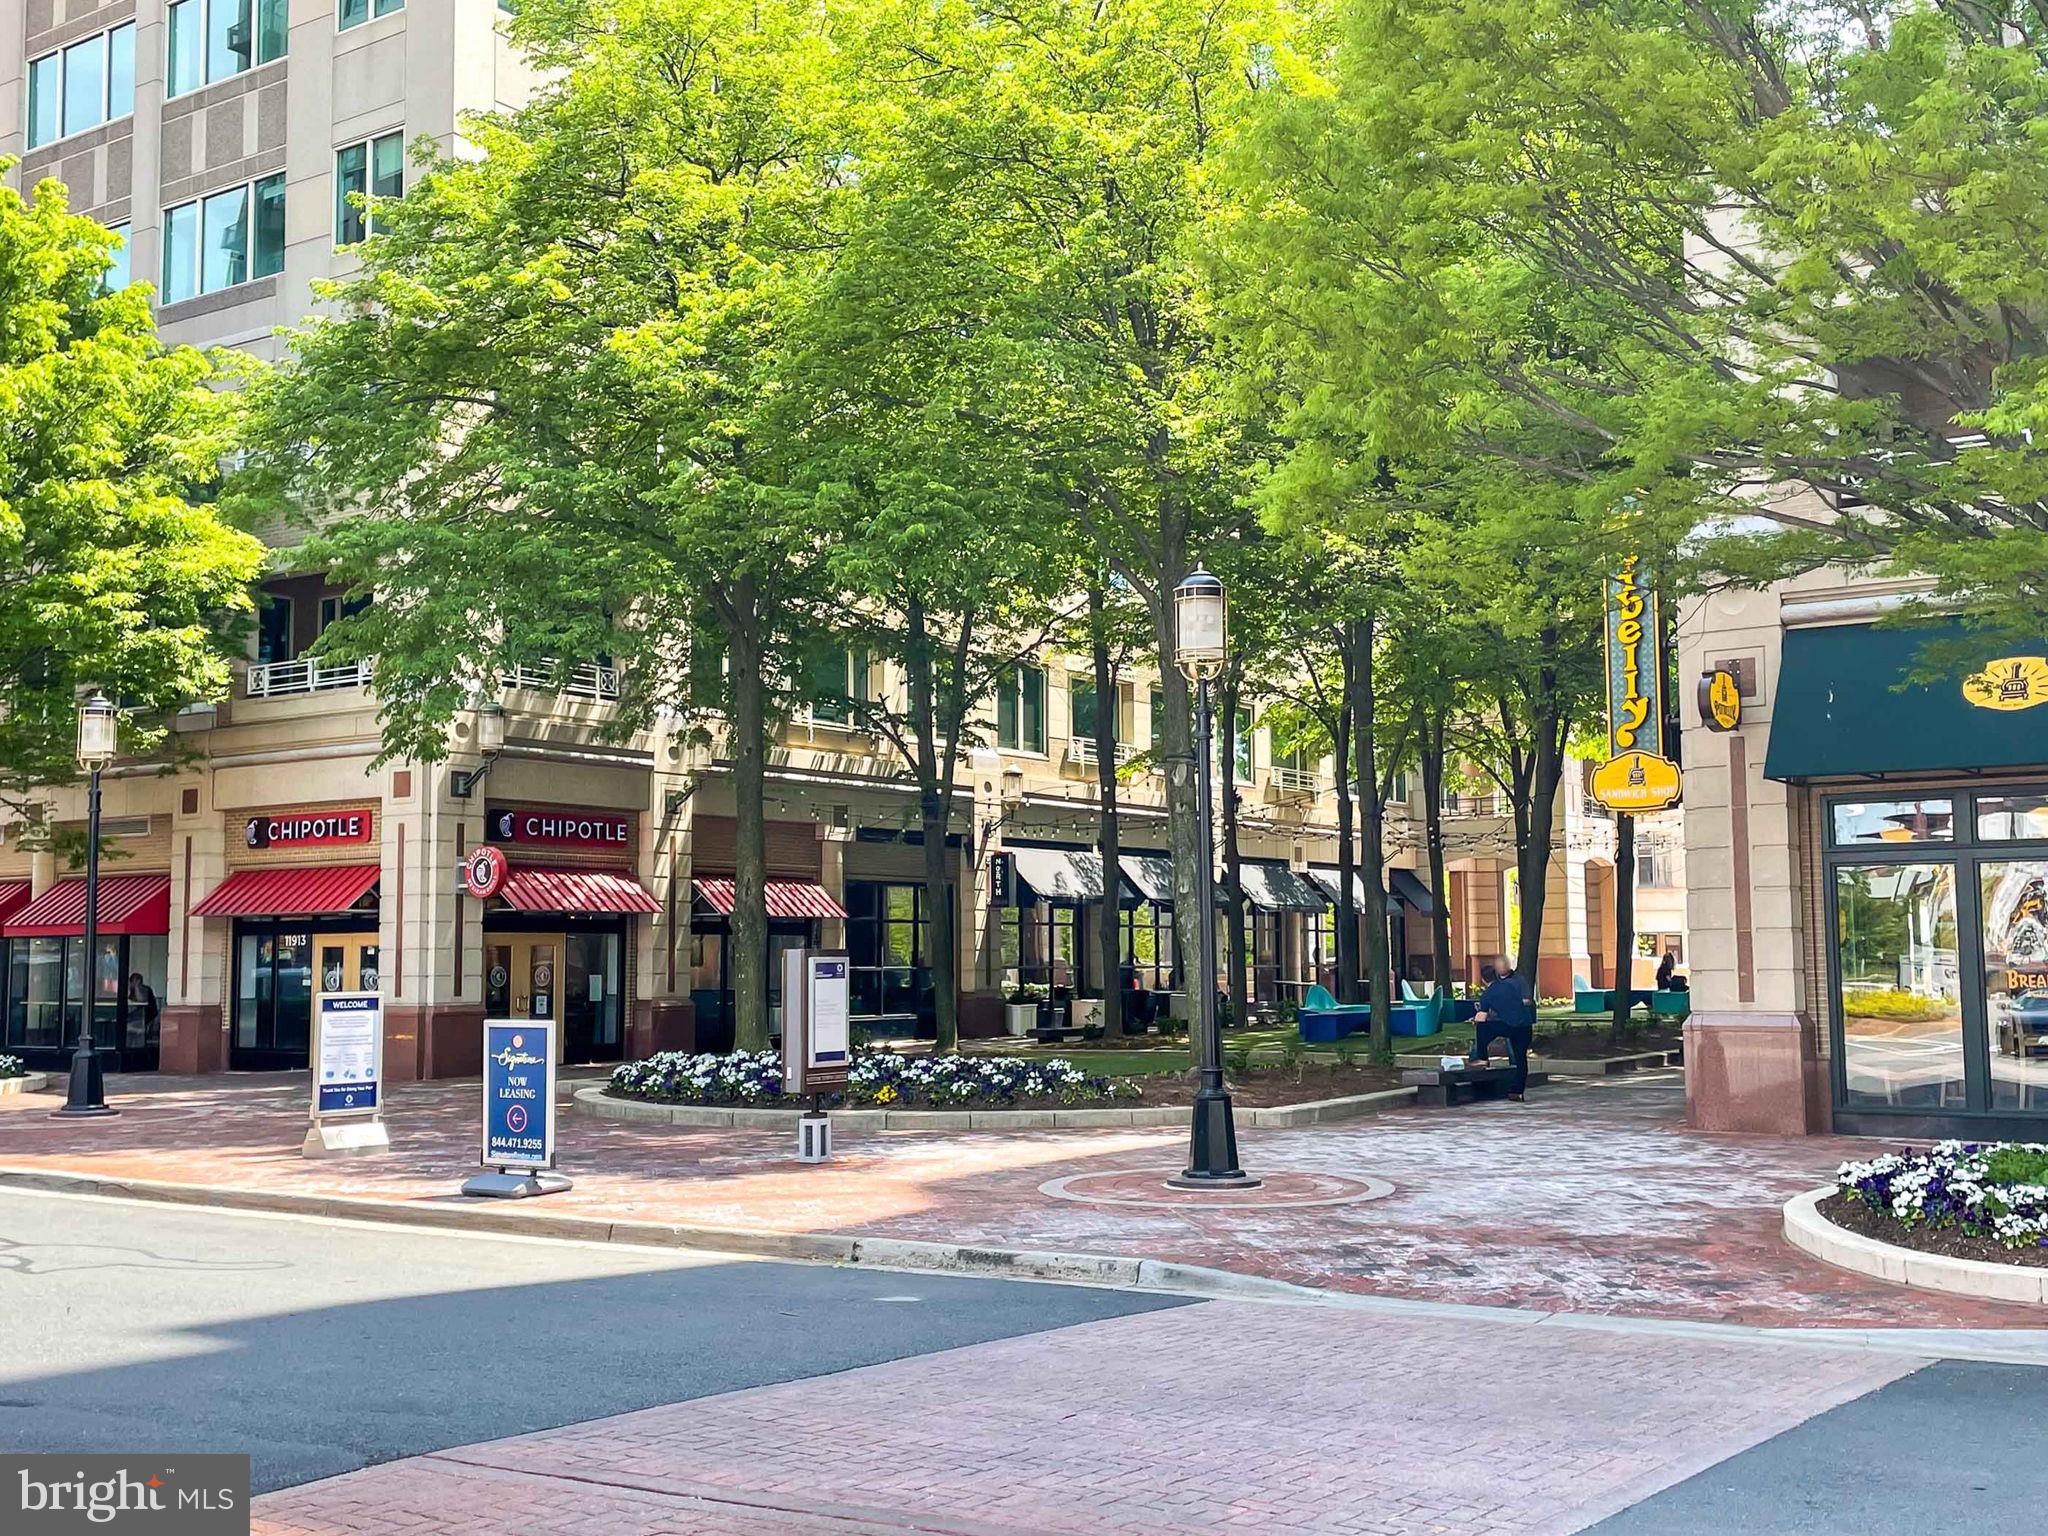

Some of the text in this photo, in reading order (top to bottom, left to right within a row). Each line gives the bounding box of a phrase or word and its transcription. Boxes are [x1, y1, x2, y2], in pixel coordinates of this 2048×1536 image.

[1599, 788, 1647, 800] SANDWICH
[268, 817, 359, 840] CHIPOTLE
[526, 818, 627, 841] CHIPOTLE
[466, 848, 497, 870] CHIPOTLE
[285, 934, 307, 947] 11913
[2006, 969, 2048, 989] BREA
[332, 1000, 368, 1009] WELCOME
[490, 1046, 545, 1072] Signature
[507, 1076, 528, 1087] NOW
[499, 1088, 536, 1099] LEASING
[491, 1136, 542, 1150] 844.471.9255
